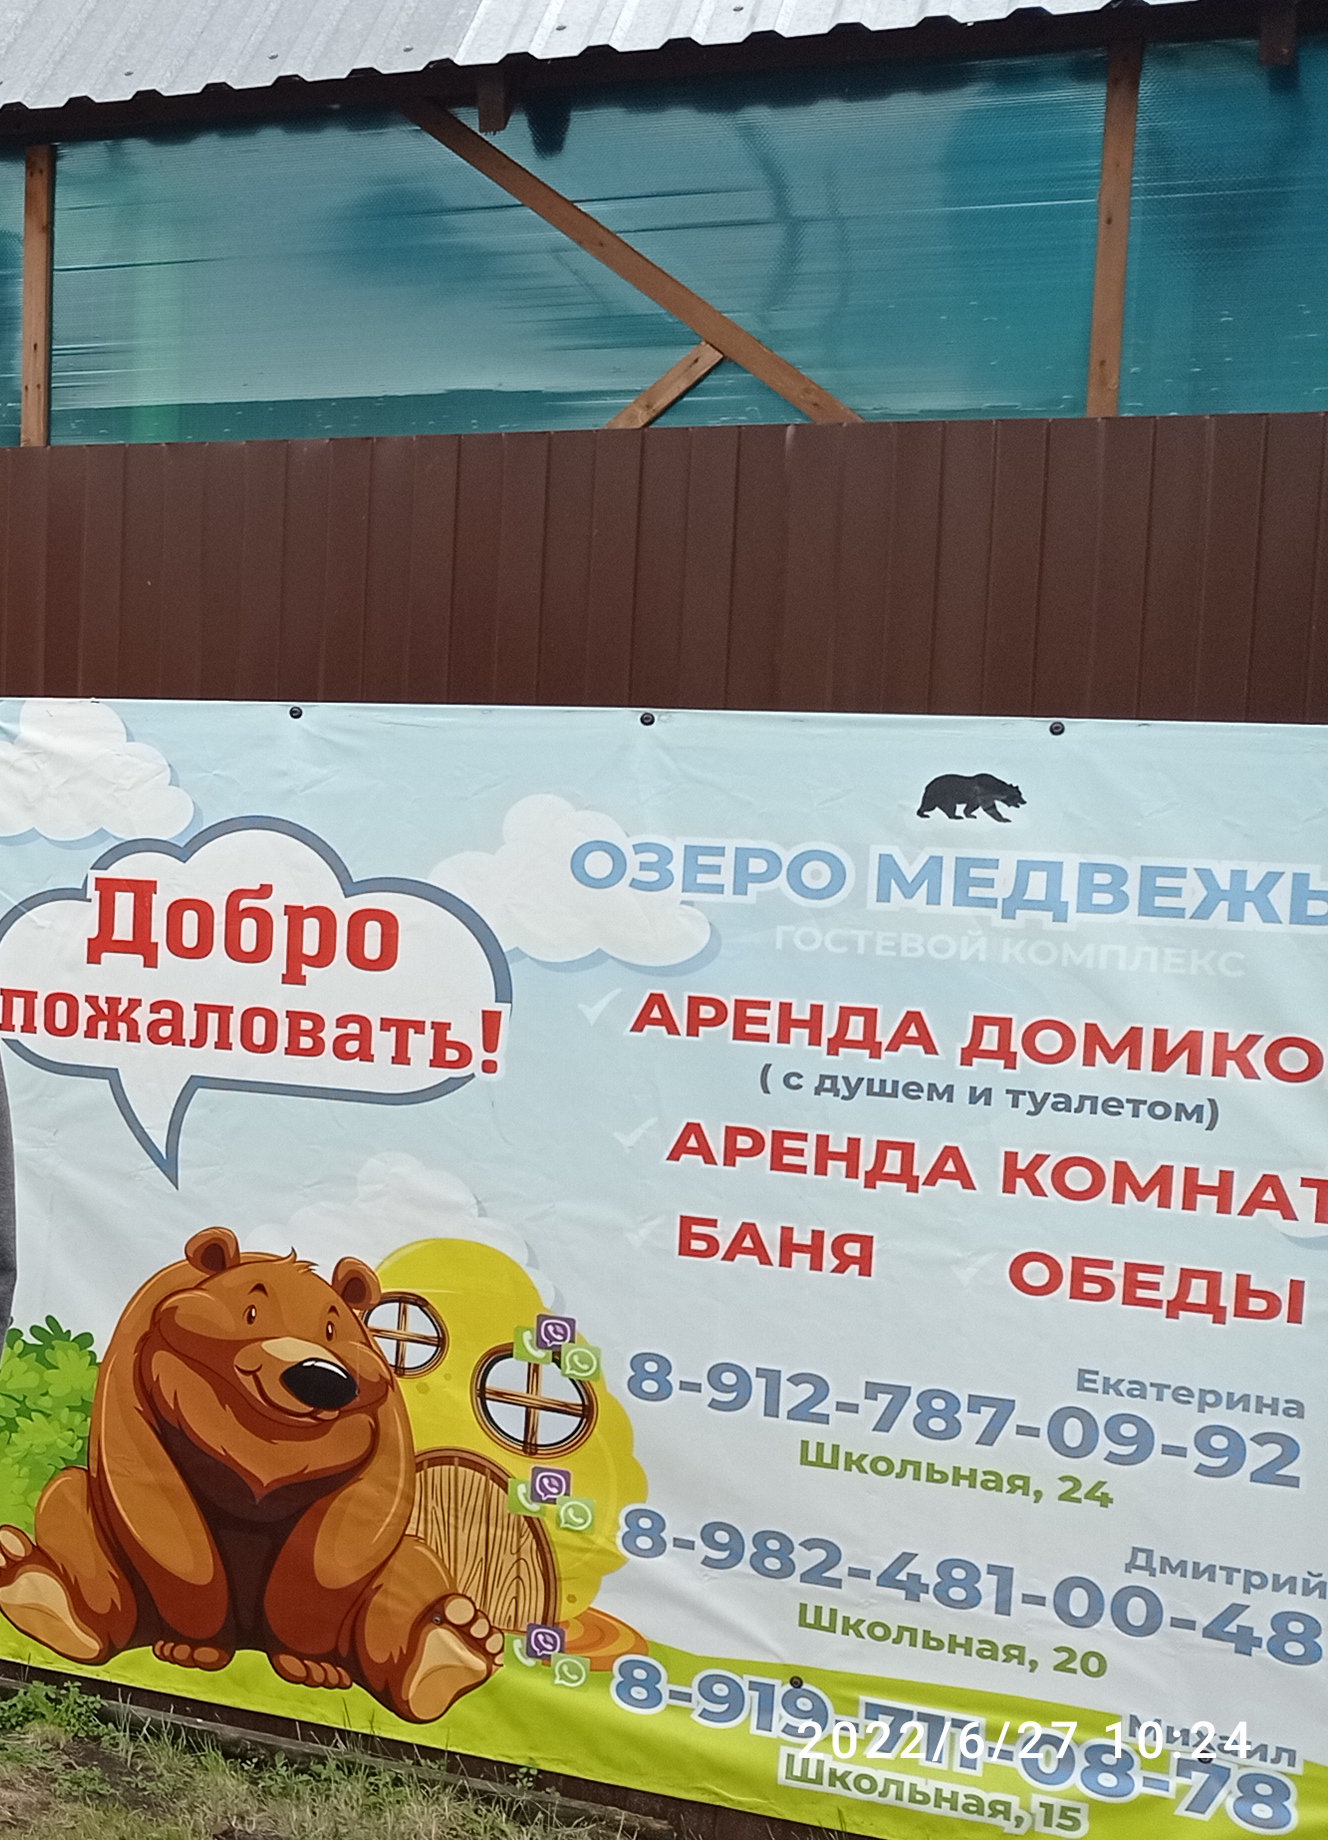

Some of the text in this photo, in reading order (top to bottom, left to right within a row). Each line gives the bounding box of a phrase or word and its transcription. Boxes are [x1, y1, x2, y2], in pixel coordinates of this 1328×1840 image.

[570, 840, 1328, 926] ОЗЕРО МЕДВЕЖЬ
[85, 876, 400, 985] Добро
[775, 924, 1245, 978] ГОСТЕВОЙ КОМПЛЕКС
[0, 987, 502, 1074] пожаловать!
[630, 991, 1325, 1084] АРЕНДА ДОМИКО
[814, 1074, 955, 1104] душем
[968, 1084, 993, 1107] и
[1005, 1086, 1220, 1131] туалетом)
[666, 1121, 1328, 1224] АРЕНДА КОМНАТ
[677, 1215, 1305, 1325] БАНЯ ОБЕДЫ
[626, 1352, 1301, 1488] 8-912-787-09-92
[1076, 1368, 1305, 1420] Екатерина
[799, 1439, 1114, 1509] Школьная, 24
[620, 1507, 1323, 1666] 8-982-481-00-48
[1124, 1546, 1328, 1600] Дмитрий
[798, 1602, 1108, 1679] Школьная, 20
[784, 1752, 1082, 1833] Школьная, 15
